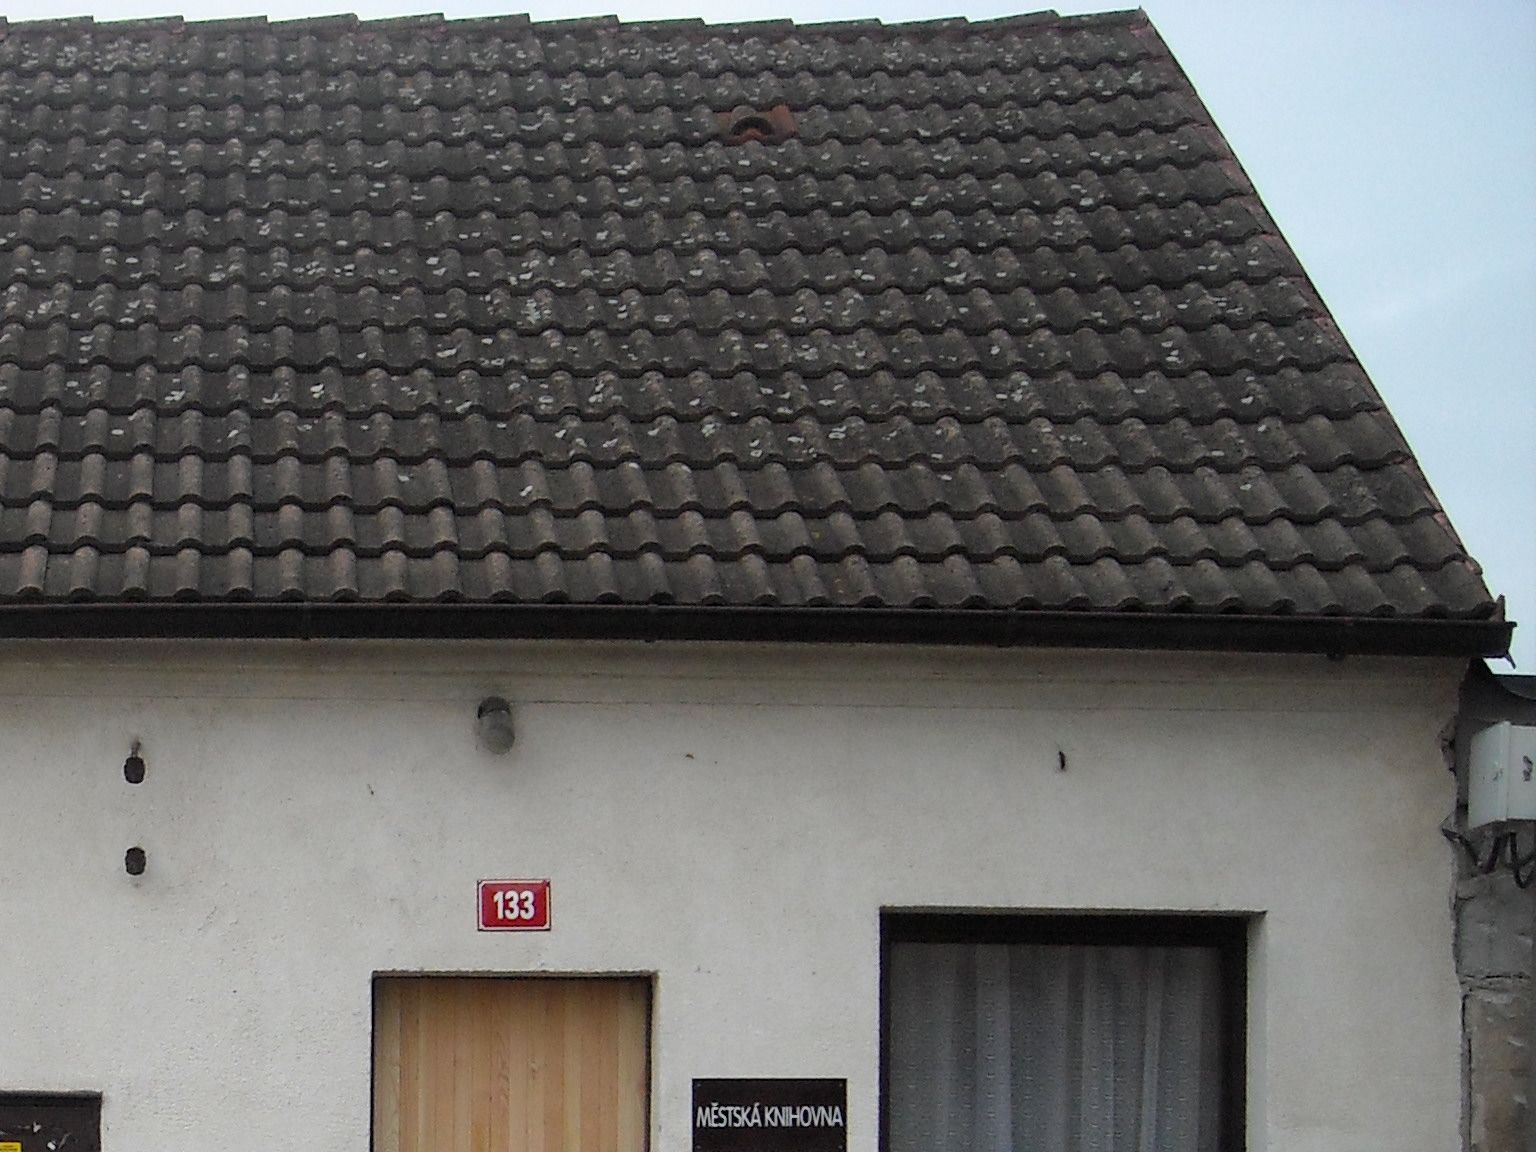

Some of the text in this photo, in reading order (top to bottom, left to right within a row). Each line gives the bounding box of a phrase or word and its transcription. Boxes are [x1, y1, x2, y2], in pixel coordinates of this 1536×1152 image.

[493, 890, 535, 920] 133
[696, 1101, 844, 1127] MĚSTSKÁ KNIHOVNA
